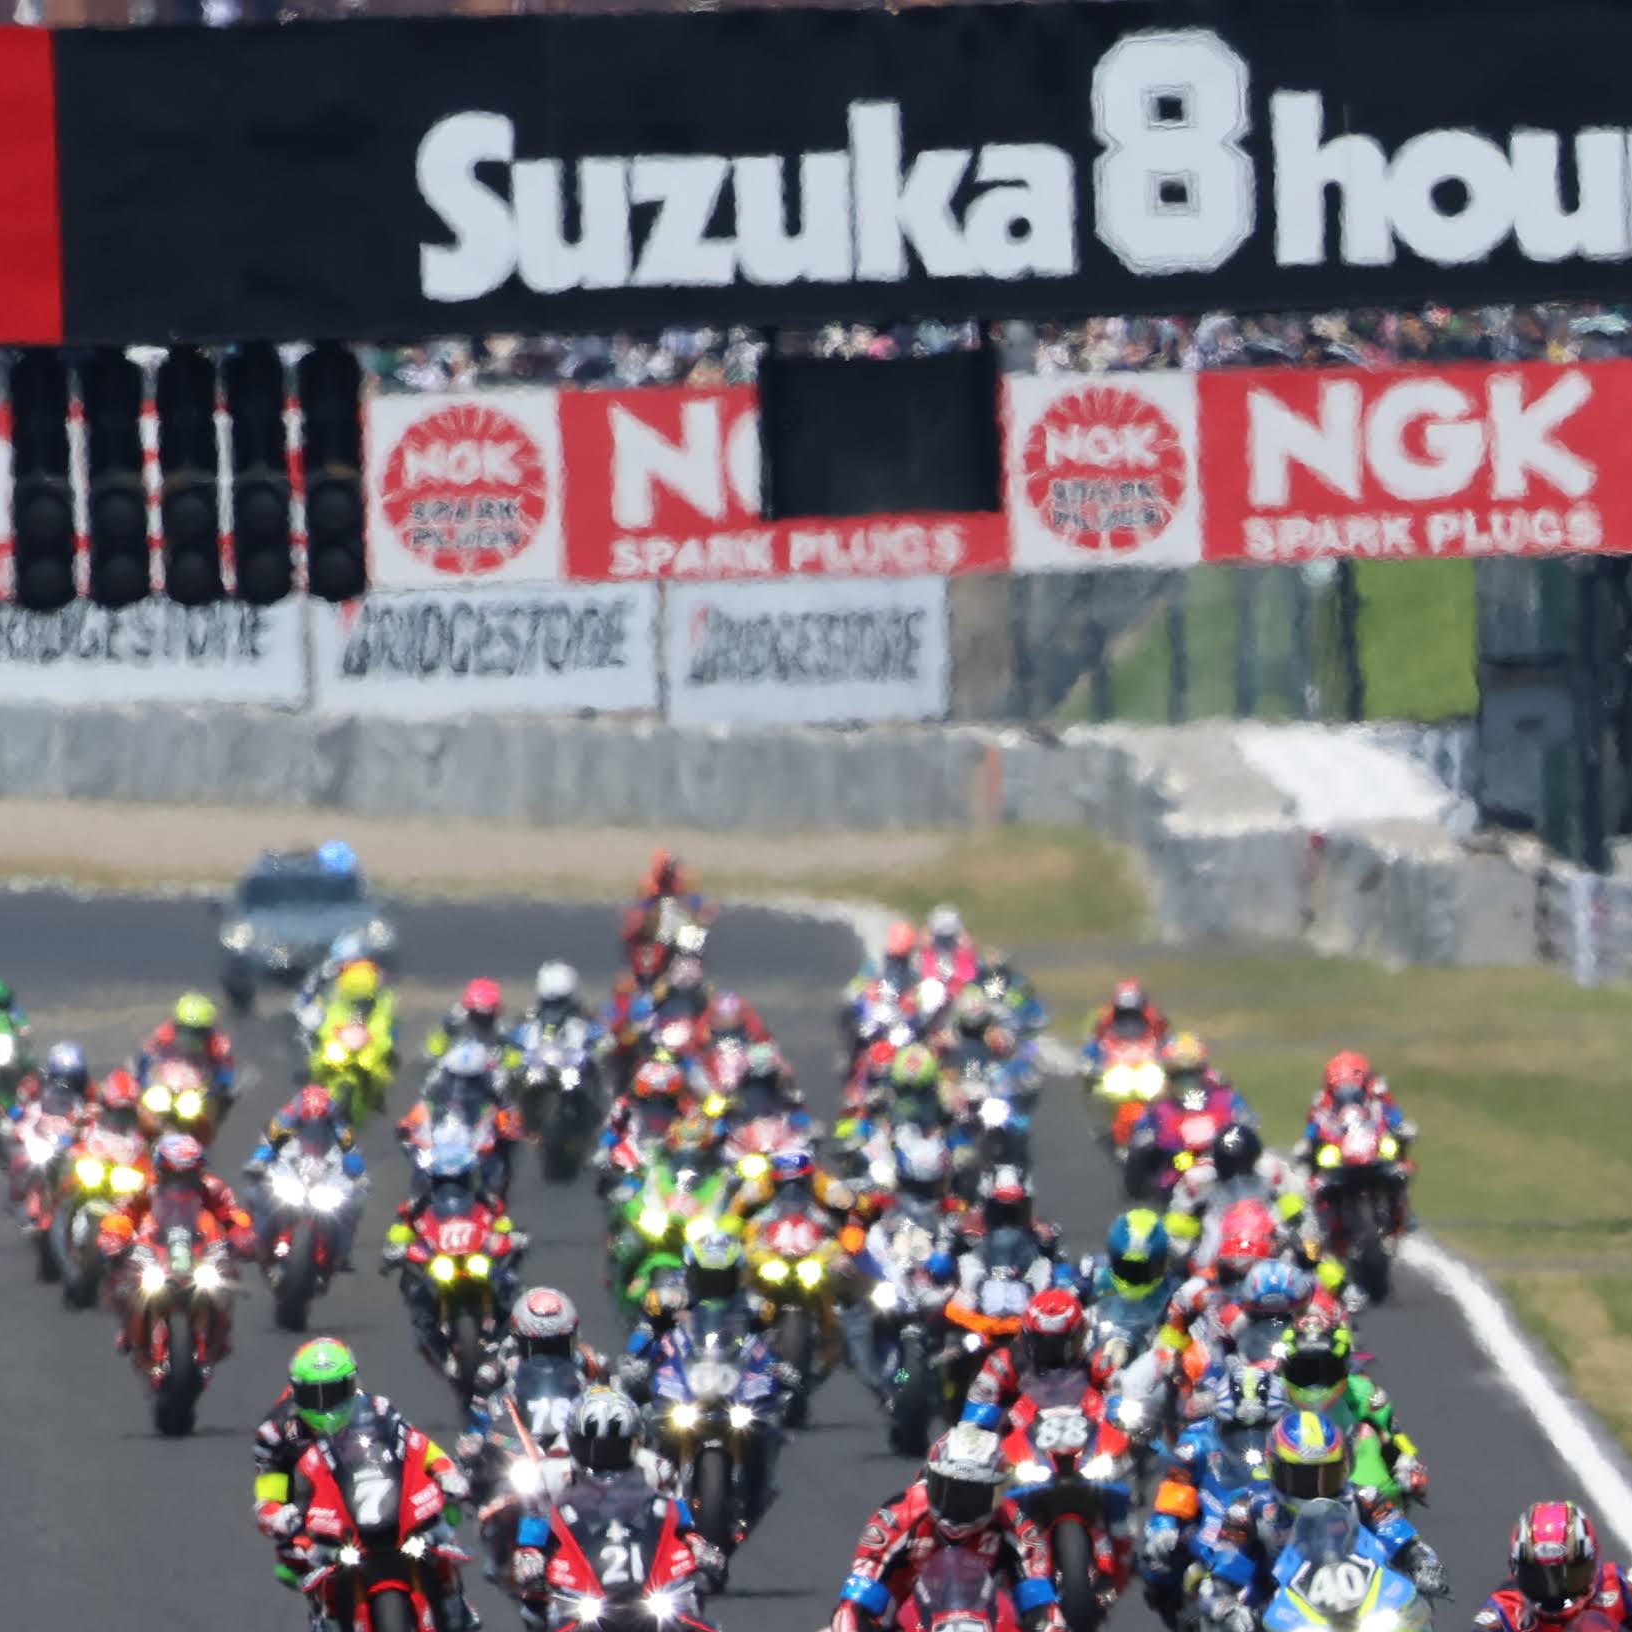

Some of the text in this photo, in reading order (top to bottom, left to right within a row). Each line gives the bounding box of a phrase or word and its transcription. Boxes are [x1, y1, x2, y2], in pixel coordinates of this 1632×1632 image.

[415, 99, 1079, 304] Suzuka
[1091, 26, 1255, 277] 8
[1044, 424, 1161, 468] NGK
[1246, 371, 1599, 508] NGK
[403, 440, 523, 487] NGK
[608, 522, 964, 577] SPARK PLUGS
[1243, 504, 1603, 558] SPARK PLUGS
[1035, 1414, 1090, 1450] 88
[353, 1478, 393, 1525] 7
[599, 1543, 646, 1586] 21
[1308, 1562, 1367, 1609] 40
